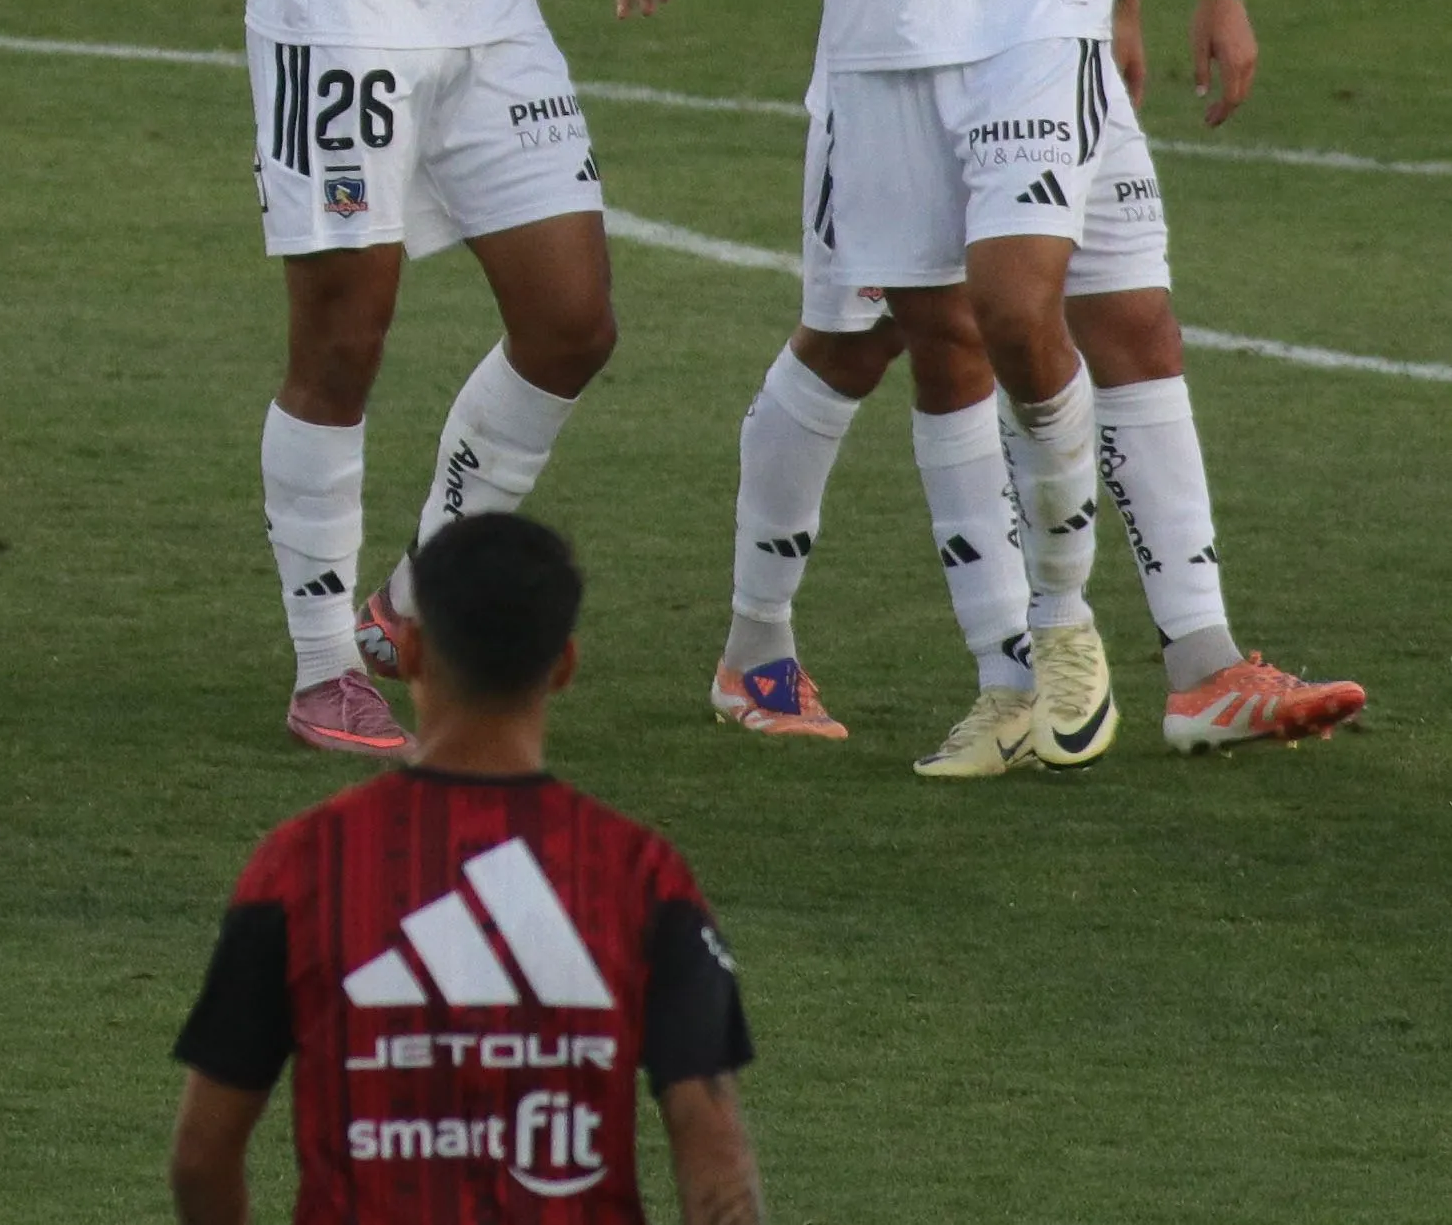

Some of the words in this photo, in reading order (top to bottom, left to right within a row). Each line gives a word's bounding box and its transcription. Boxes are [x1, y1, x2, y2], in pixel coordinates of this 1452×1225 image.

[315, 68, 396, 150] 26
[509, 94, 580, 126] PHILI
[517, 130, 541, 149] TV
[548, 126, 562, 143] &
[968, 117, 1072, 150] PHILIPS
[993, 147, 1007, 164] &
[1013, 144, 1073, 166] Audio
[1100, 424, 1162, 575] utoPlanet
[345, 1033, 618, 1071] JETOUR
[348, 1114, 506, 1161] smart
